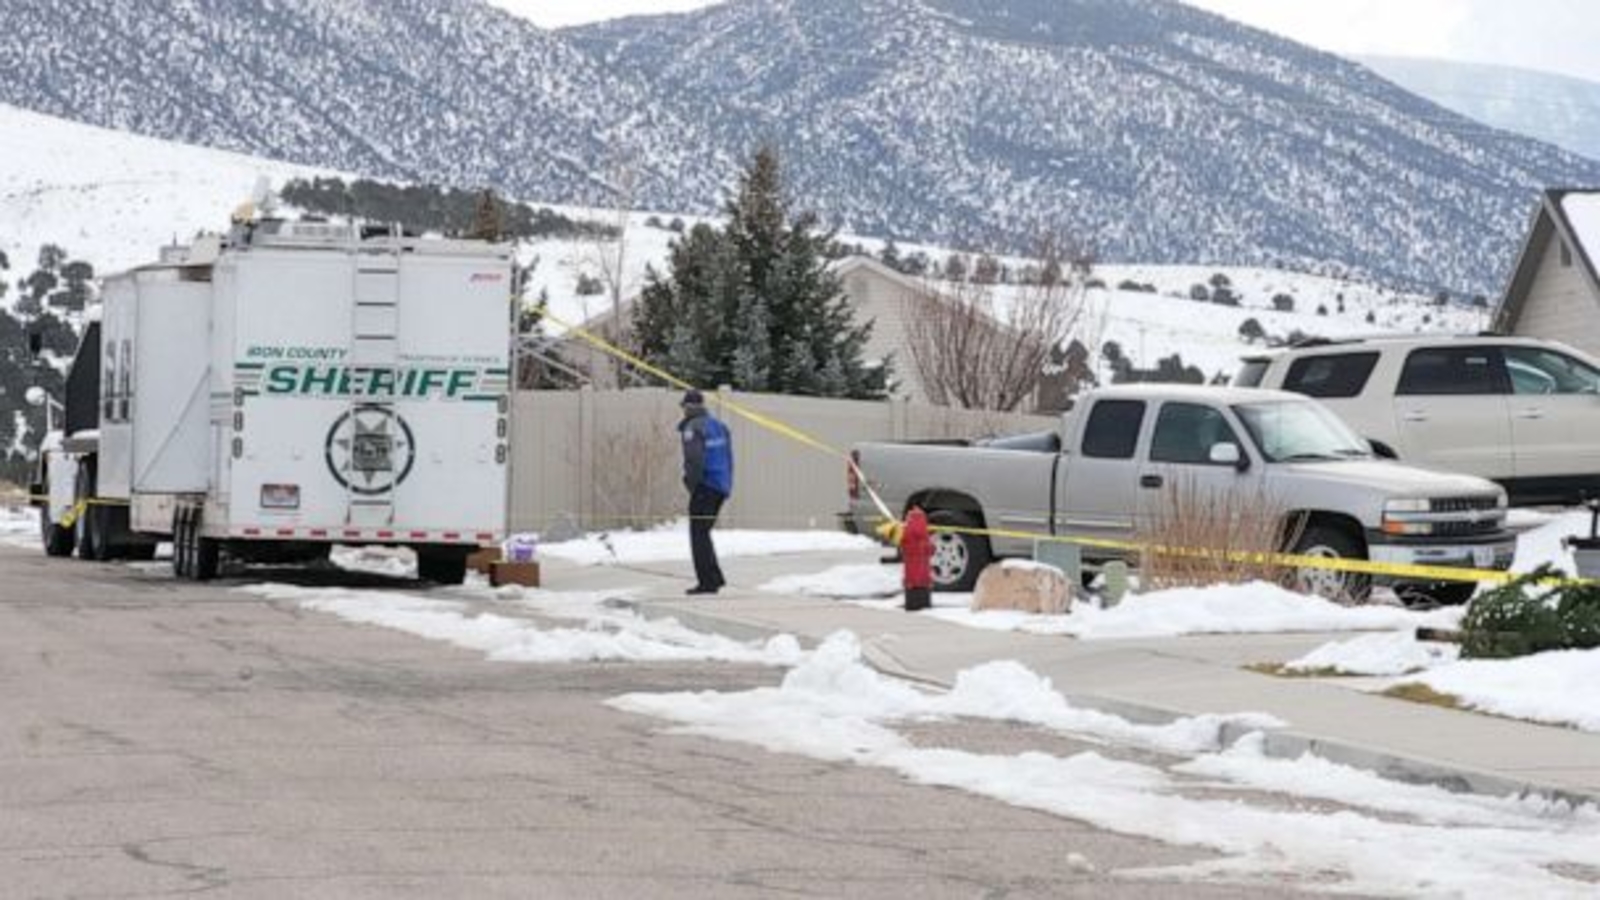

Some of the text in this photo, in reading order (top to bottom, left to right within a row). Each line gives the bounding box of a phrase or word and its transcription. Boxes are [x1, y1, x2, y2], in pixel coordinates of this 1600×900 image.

[247, 346, 348, 359] IRON COUNTY
[267, 366, 477, 396] SHERIFF
